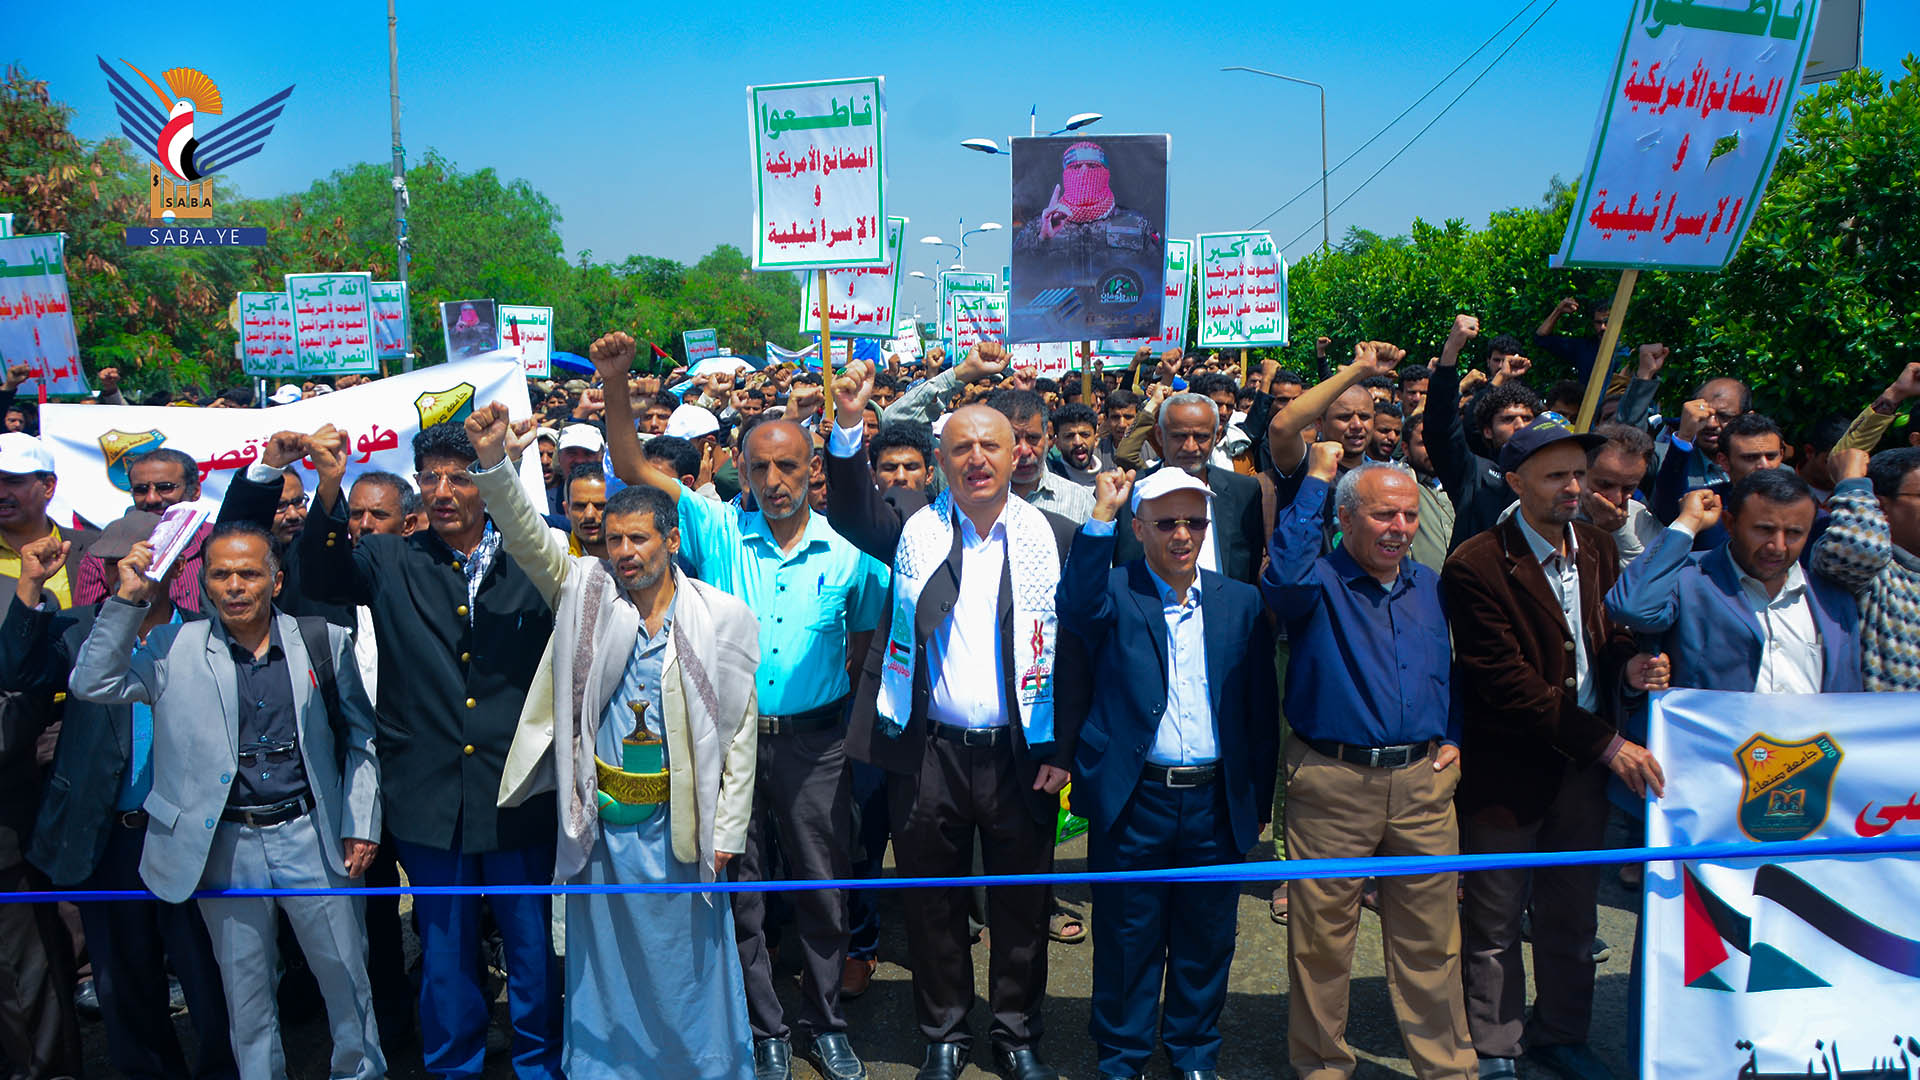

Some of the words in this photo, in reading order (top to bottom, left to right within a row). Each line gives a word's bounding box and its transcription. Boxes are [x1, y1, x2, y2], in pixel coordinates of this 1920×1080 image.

[1624, 58, 1709, 115] الأمريكية
[1701, 67, 1784, 122] البضائع
[762, 95, 872, 140] قاطعوا
[766, 144, 821, 178] الأمريكية
[823, 145, 873, 176] البضائع
[1672, 133, 1690, 172] و
[814, 184, 821, 206] و
[1588, 189, 1743, 244] الإسرائيلية
[768, 215, 876, 249] الإسرائيلية
[1247, 263, 1279, 278] الموت
[338, 279, 364, 295] الله
[1247, 283, 1279, 297] الموت
[1207, 304, 1233, 318] اليهود
[1236, 303, 1251, 316] على
[1248, 318, 1279, 339] النصر
[1784, 750, 1818, 773] جامعة
